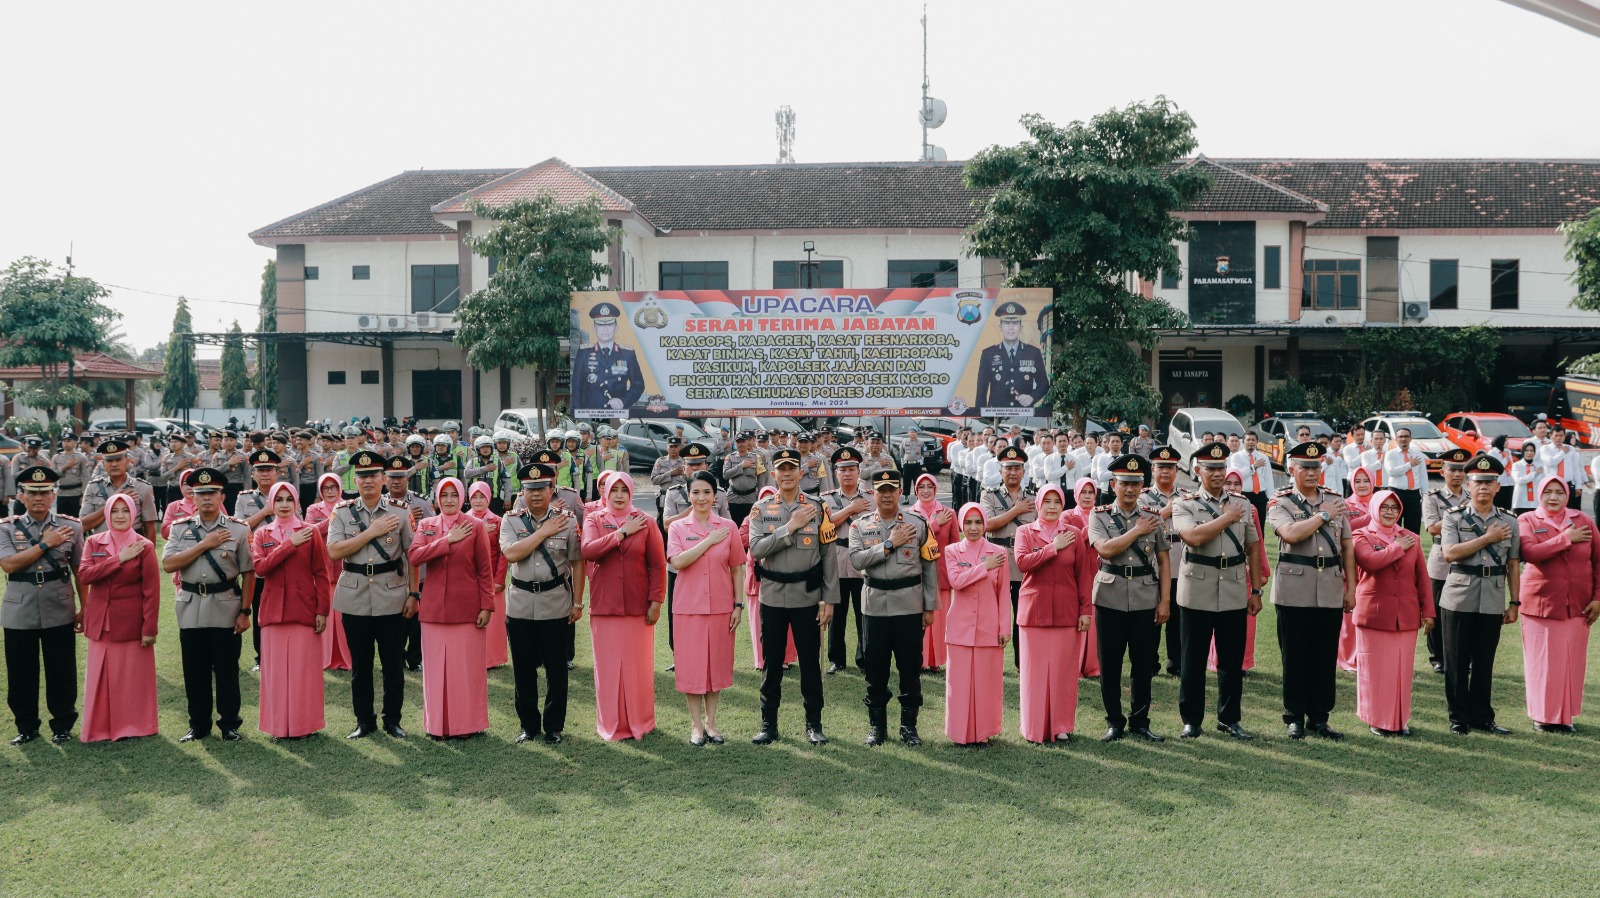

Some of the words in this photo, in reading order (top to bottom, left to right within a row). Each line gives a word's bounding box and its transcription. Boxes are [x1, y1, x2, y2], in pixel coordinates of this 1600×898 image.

[743, 296, 875, 315] UPACARA
[684, 318, 754, 333] SERAH
[757, 317, 836, 332] TERIMA
[841, 317, 936, 331] JABATAN
[660, 336, 736, 348] KABAGOPS,
[738, 335, 816, 348] KABAGREN,
[818, 334, 862, 346] KASAT
[864, 334, 960, 347] RESNARKOBA,
[667, 349, 710, 360] KASAT
[713, 348, 768, 362] BINMAS,
[770, 348, 814, 360] KASAT
[816, 348, 860, 360] TAHTI,
[862, 347, 953, 360] KASIPROPAM,
[693, 362, 757, 374] KASIKUM,
[759, 361, 830, 373] KAPOLSEK
[832, 360, 894, 372] JAJARAN
[896, 360, 926, 372] DAN
[669, 374, 762, 386] PENGUKUHAN
[763, 374, 824, 386] JABATAN
[827, 373, 898, 386] KAPOLSEK
[900, 372, 950, 385] NGORO
[686, 388, 730, 400] SERTA
[731, 387, 810, 400] KASIHUMAS
[812, 386, 864, 398] POLRES
[866, 386, 933, 398] JOMBANG
